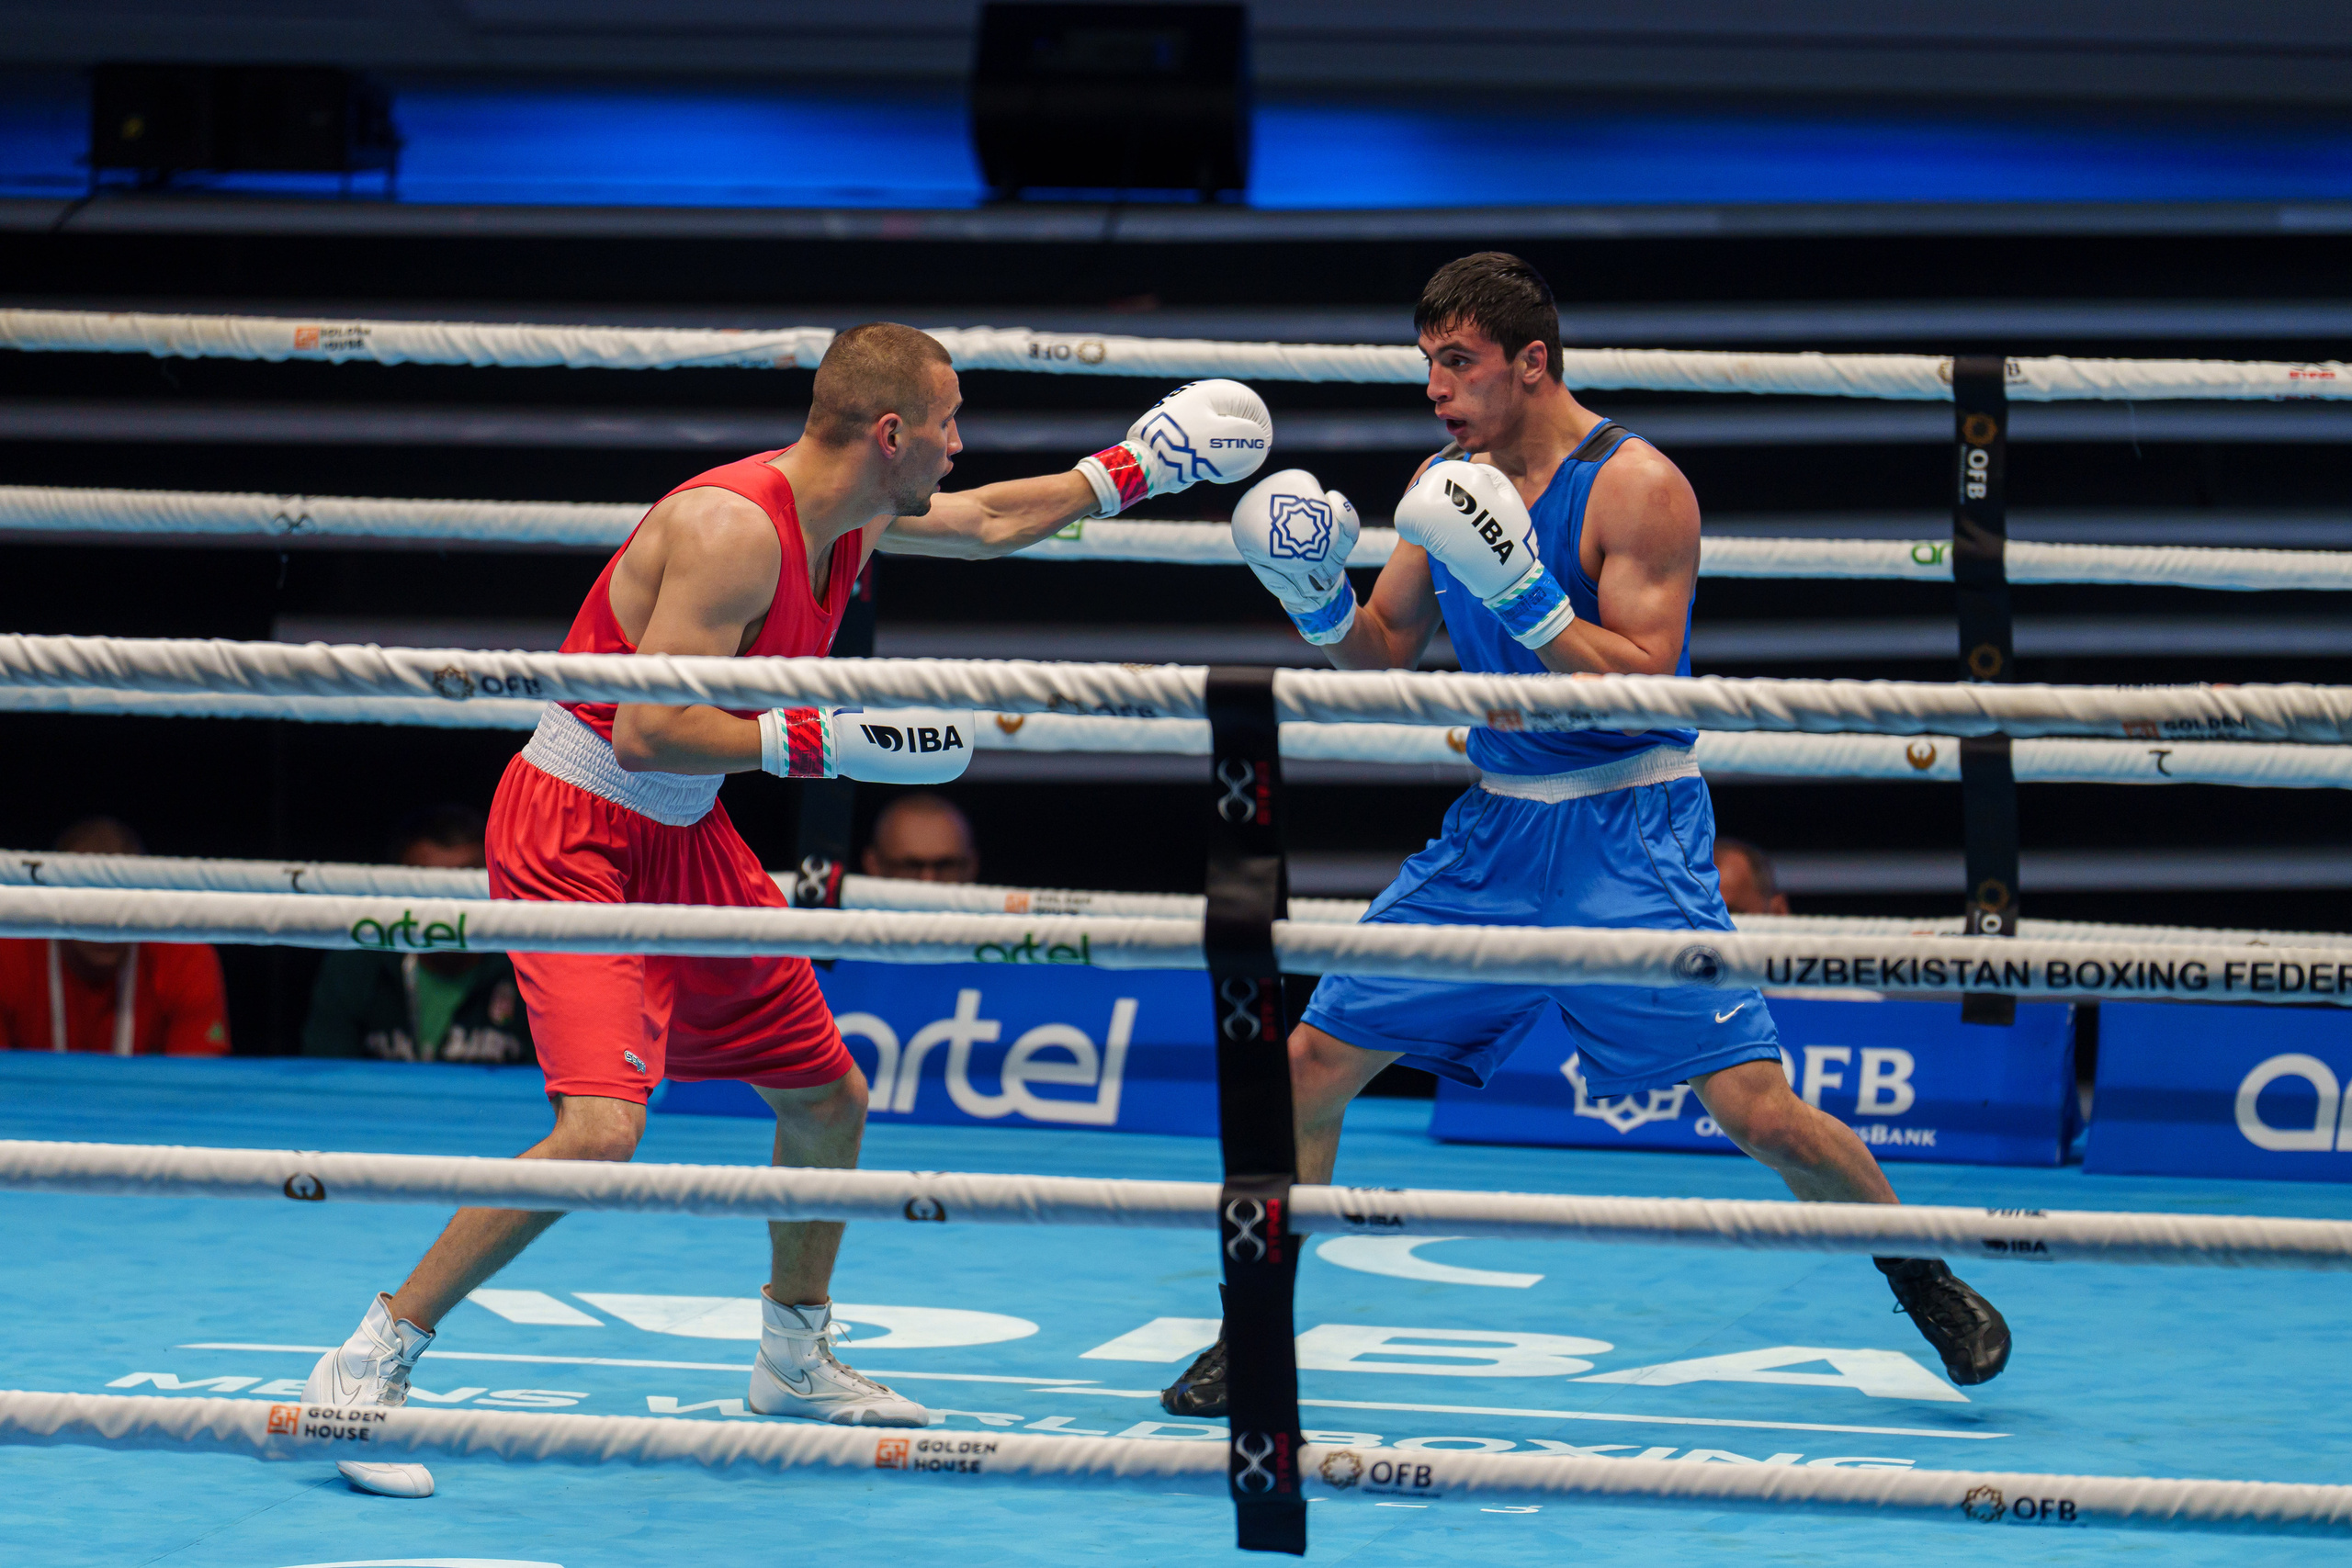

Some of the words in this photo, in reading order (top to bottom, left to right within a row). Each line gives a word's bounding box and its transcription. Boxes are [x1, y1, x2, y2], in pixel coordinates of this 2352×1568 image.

[1209, 438, 1265, 449] STING
[1966, 448, 1989, 500] OFB
[1471, 508, 1515, 566] IBA
[906, 725, 965, 753] IBA
[351, 908, 467, 950] artel
[974, 931, 1091, 964] artel
[1765, 956, 2031, 988] UZBEKISTAN
[2045, 960, 2209, 991] BOXING
[1779, 1044, 1916, 1117] FB
[308, 1407, 387, 1422] GOLDEN
[646, 1394, 1231, 1440] WRLD
[304, 1425, 371, 1441] HOUSE
[917, 1438, 998, 1455] GOLDEN
[914, 1459, 981, 1473] HOUSE
[1369, 1461, 1432, 1489] OFB
[2012, 1496, 2078, 1522] OFB
